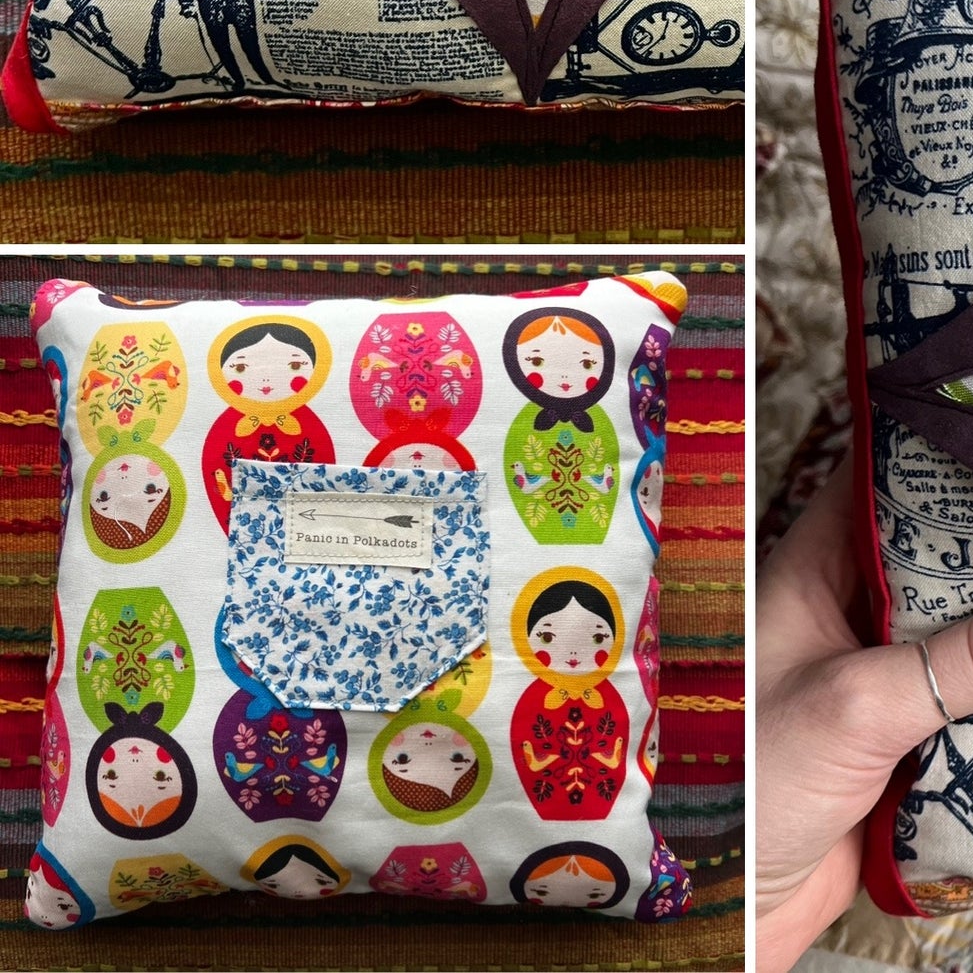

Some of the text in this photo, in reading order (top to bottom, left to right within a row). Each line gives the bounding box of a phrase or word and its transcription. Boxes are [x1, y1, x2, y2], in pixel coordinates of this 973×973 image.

[934, 244, 970, 271] sont
[296, 532, 418, 549] Panic in Polkadots
[902, 585, 948, 615] Rue
